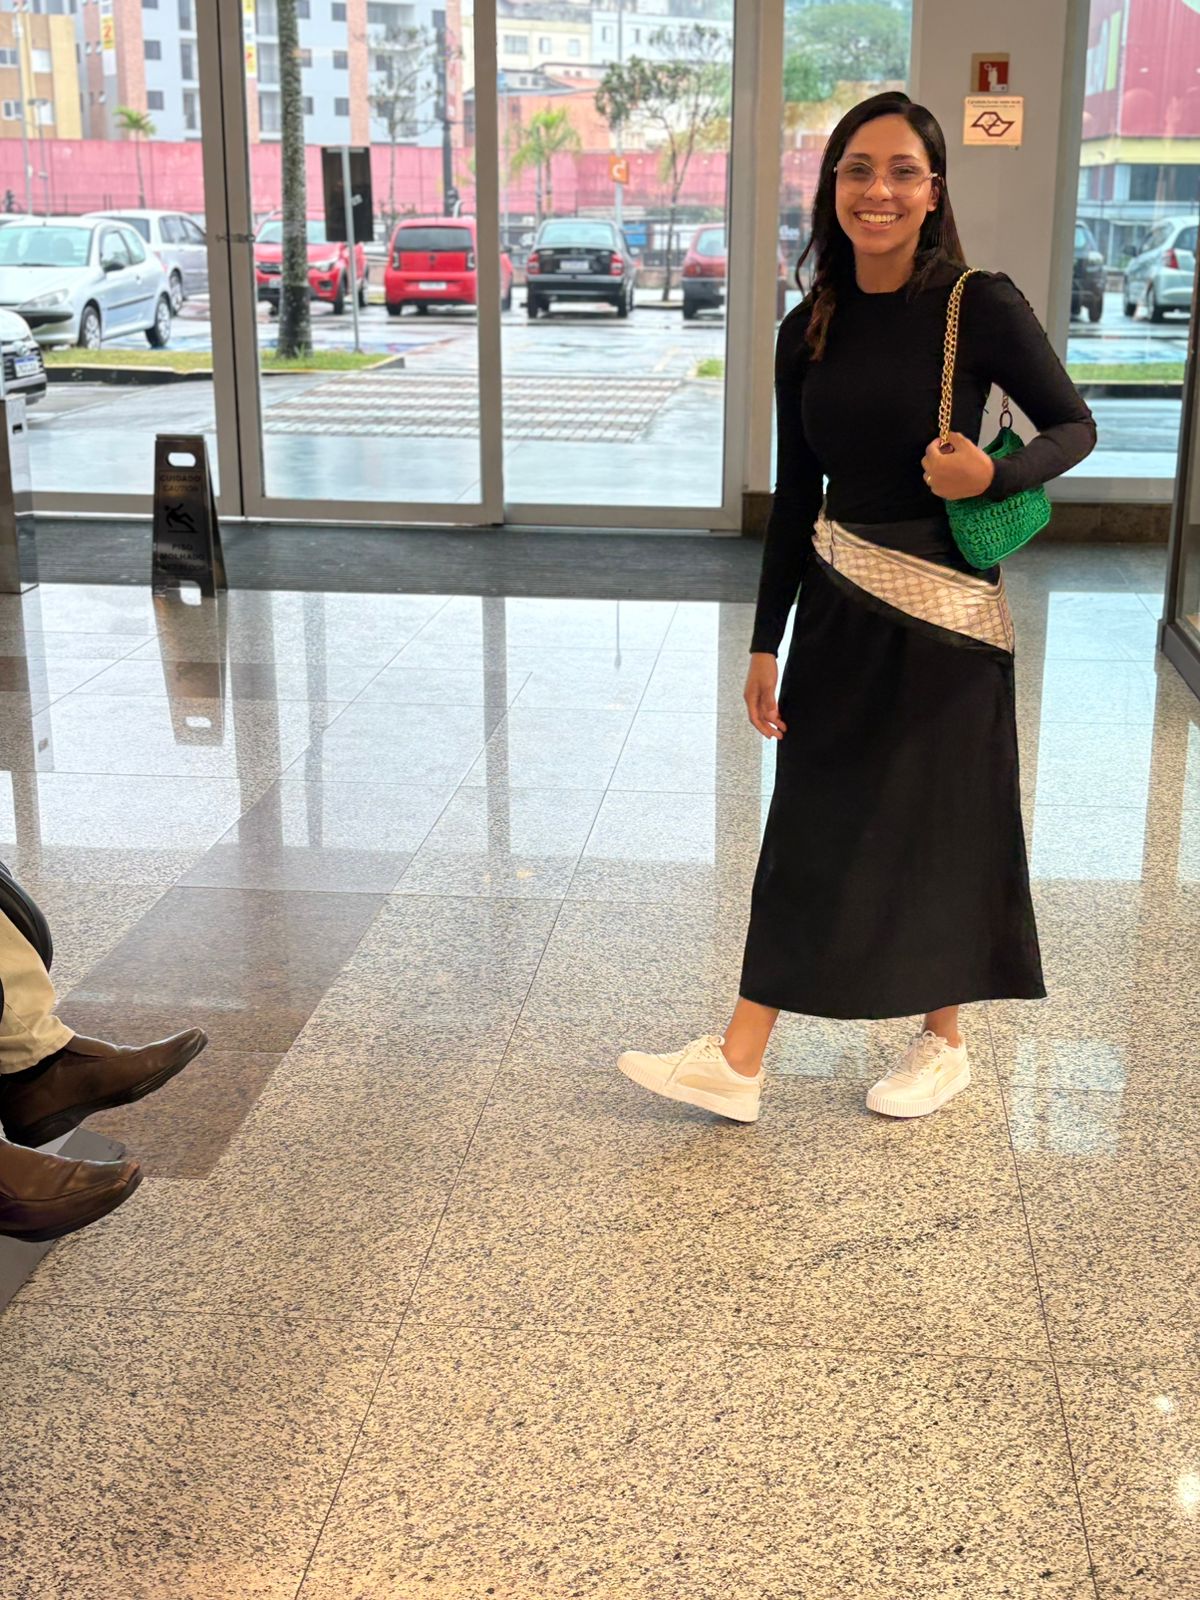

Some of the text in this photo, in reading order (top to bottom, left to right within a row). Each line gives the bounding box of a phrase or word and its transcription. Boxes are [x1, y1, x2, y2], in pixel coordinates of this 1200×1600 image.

[159, 474, 201, 482] CUIDADO
[163, 484, 199, 492] CAUTION
[172, 543, 193, 551] PISO
[159, 552, 205, 560] MOLHADO
